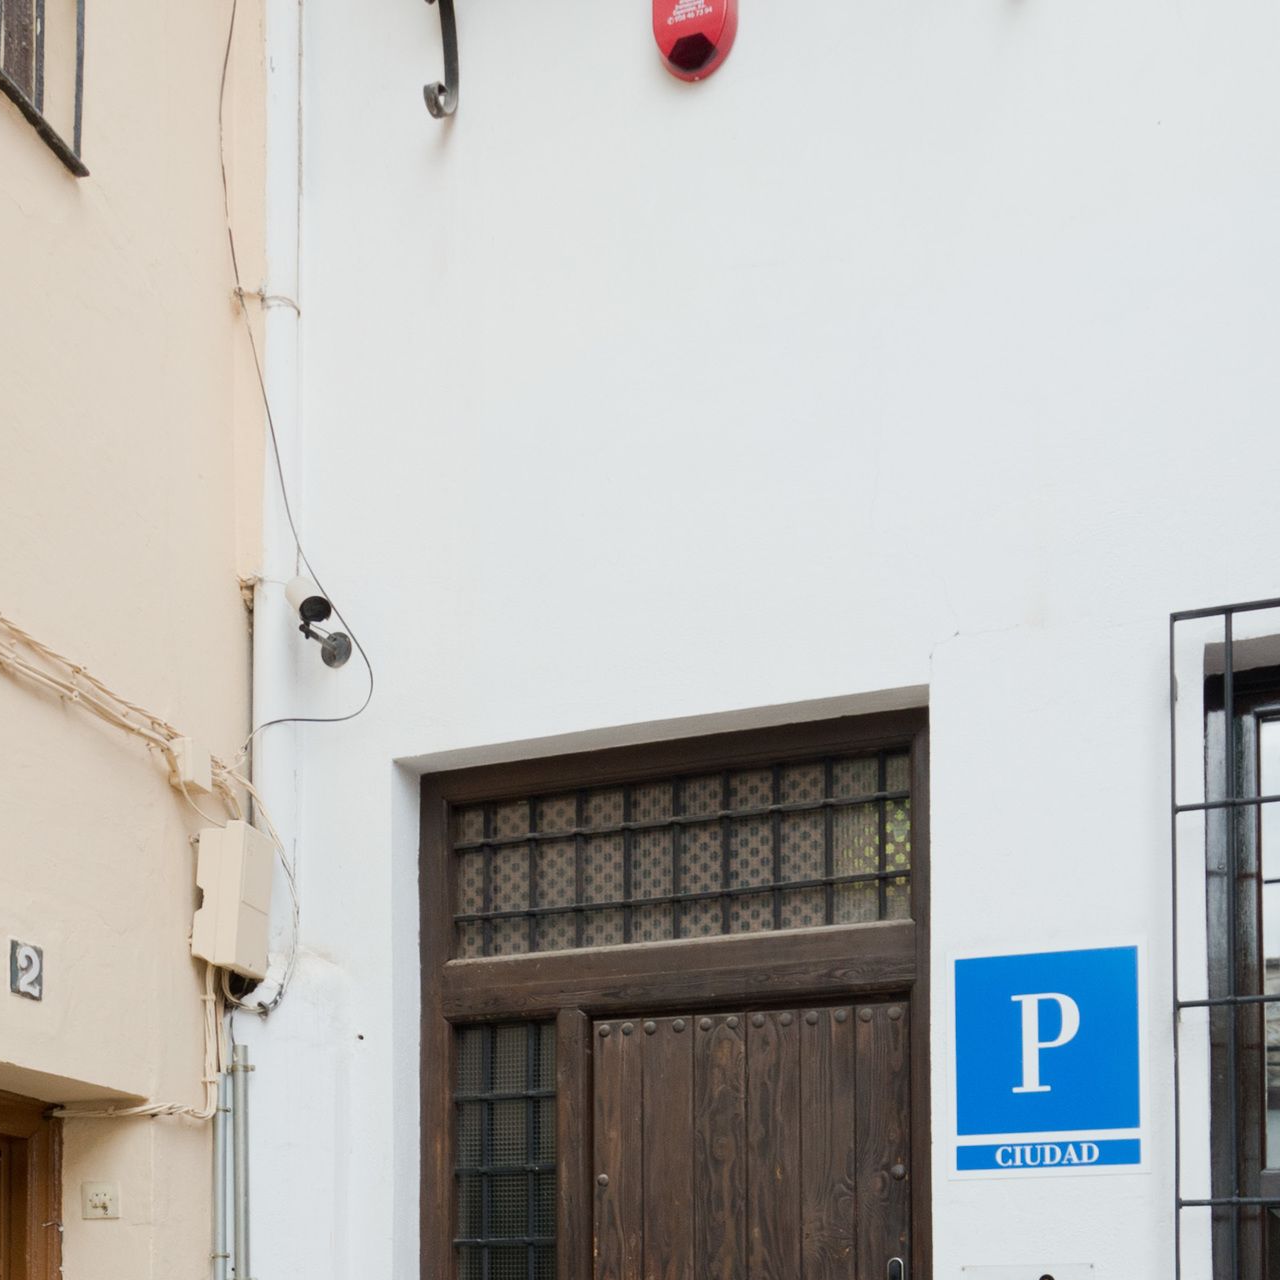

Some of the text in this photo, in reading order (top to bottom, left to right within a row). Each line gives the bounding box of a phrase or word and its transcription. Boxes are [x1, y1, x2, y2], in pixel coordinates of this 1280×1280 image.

[18, 946, 40, 997] 2
[1011, 992, 1081, 1093] P
[995, 1142, 1100, 1167] CIUDAD
